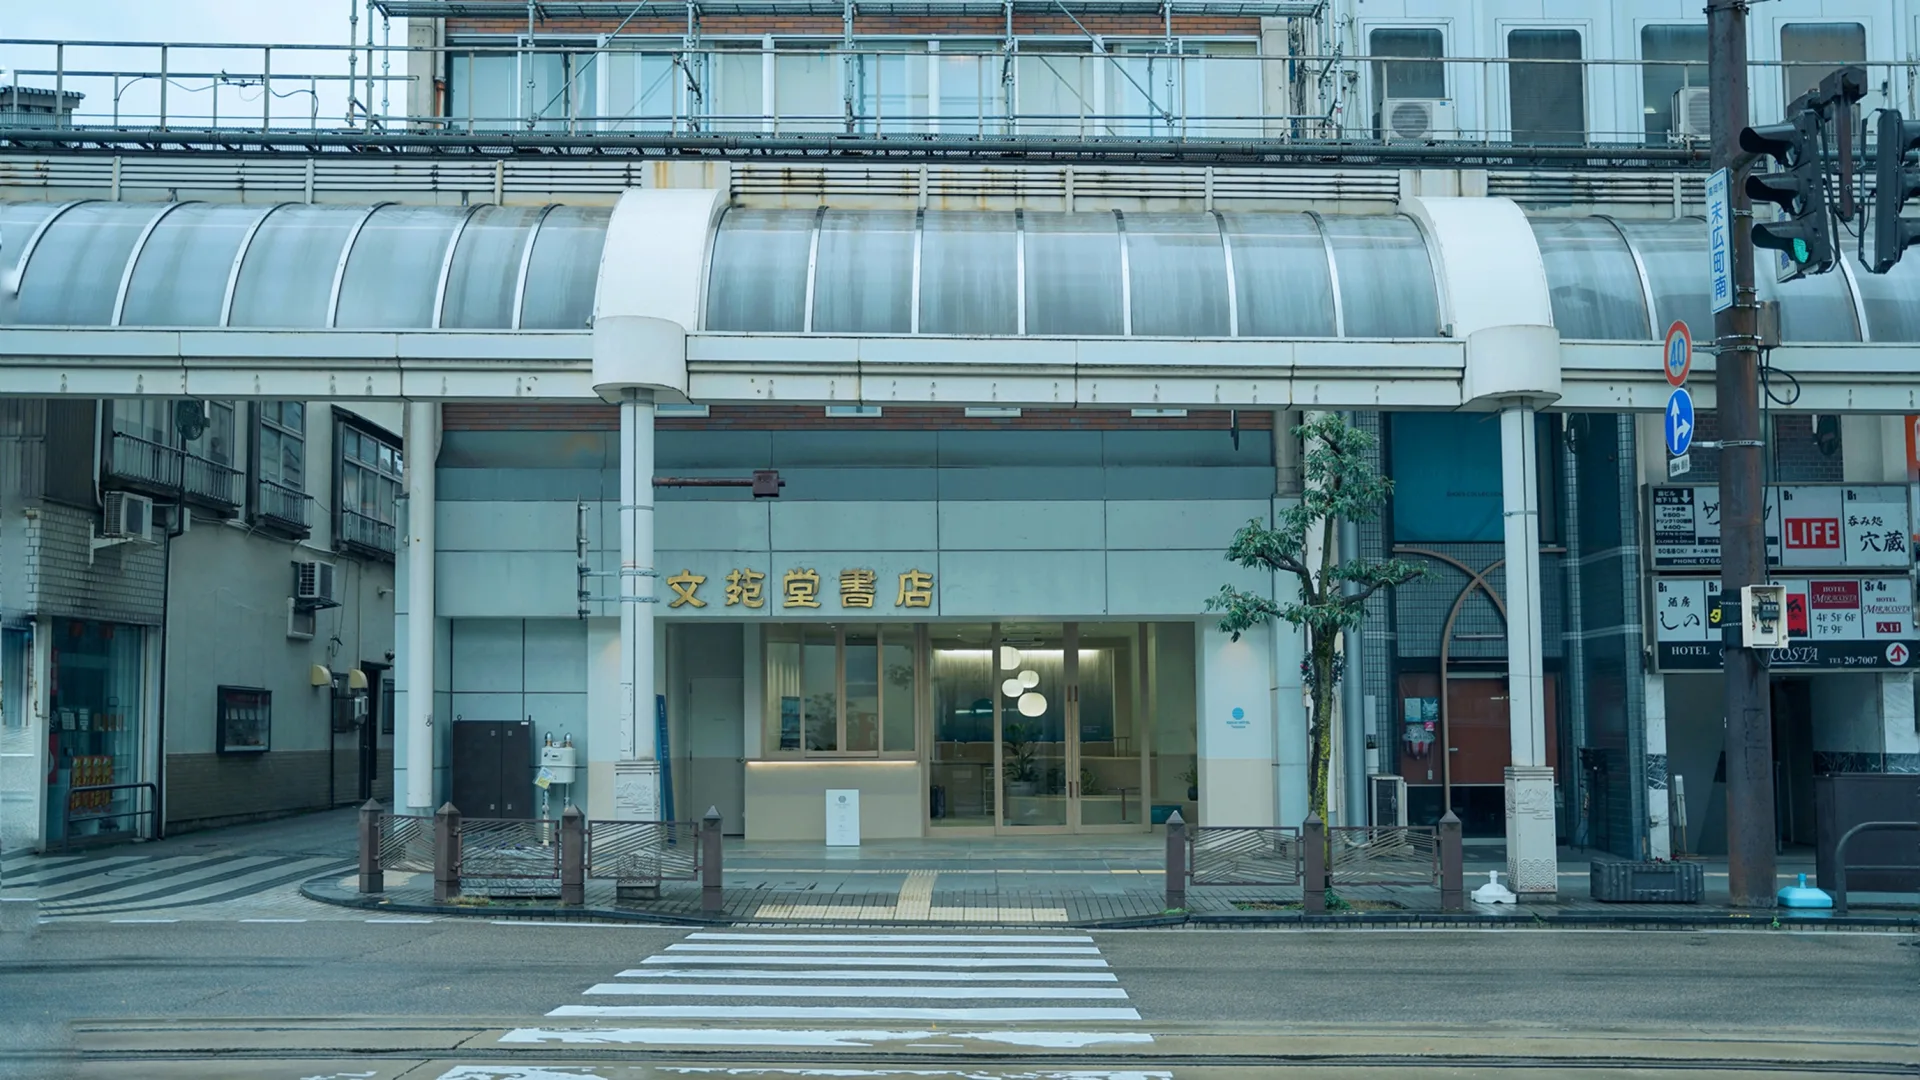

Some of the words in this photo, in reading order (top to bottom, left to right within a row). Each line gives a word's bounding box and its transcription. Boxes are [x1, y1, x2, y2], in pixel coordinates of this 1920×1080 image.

[1711, 200, 1727, 302] 末広町南
[1670, 338, 1685, 367] 40
[1783, 490, 1793, 501] B1
[1847, 490, 1857, 501] B1
[1848, 515, 1883, 527] 呑み処
[1787, 522, 1837, 545] LIFE
[1860, 529, 1906, 553] 穴蔵
[666, 567, 934, 609] 文苑堂書店
[1658, 582, 1668, 593] B1
[1708, 582, 1718, 593] B1
[1659, 610, 1700, 631] しの
[1816, 613, 1828, 622] 4F
[1830, 612, 1842, 622] 5F
[1844, 612, 1857, 622] 6F
[1817, 625, 1829, 634] 7F
[1830, 624, 1843, 634] 9F
[1671, 646, 1710, 655] HOTEL
[1844, 656, 1878, 665] 20-7007
